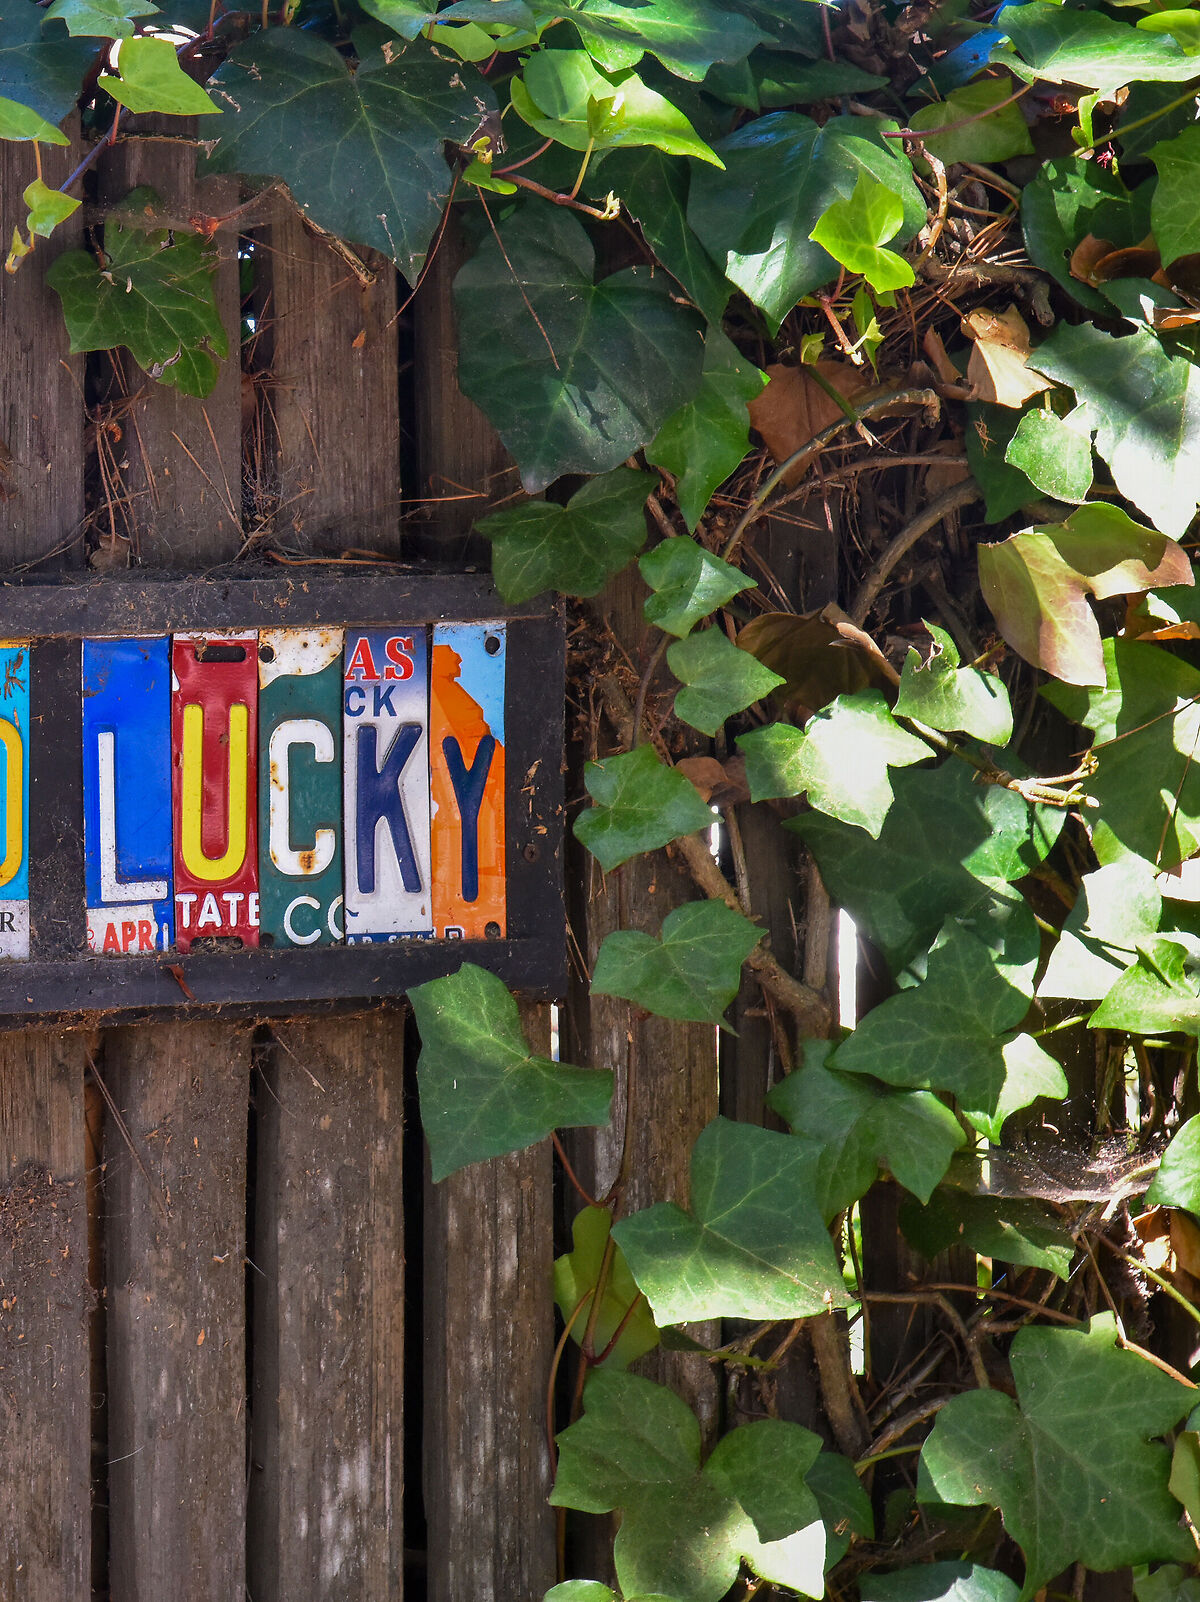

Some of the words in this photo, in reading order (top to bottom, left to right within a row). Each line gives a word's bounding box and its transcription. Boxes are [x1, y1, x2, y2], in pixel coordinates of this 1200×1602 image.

[344, 636, 415, 681] AS
[344, 685, 398, 718] CK
[97, 702, 496, 903] LUCKY
[102, 919, 155, 953] APR
